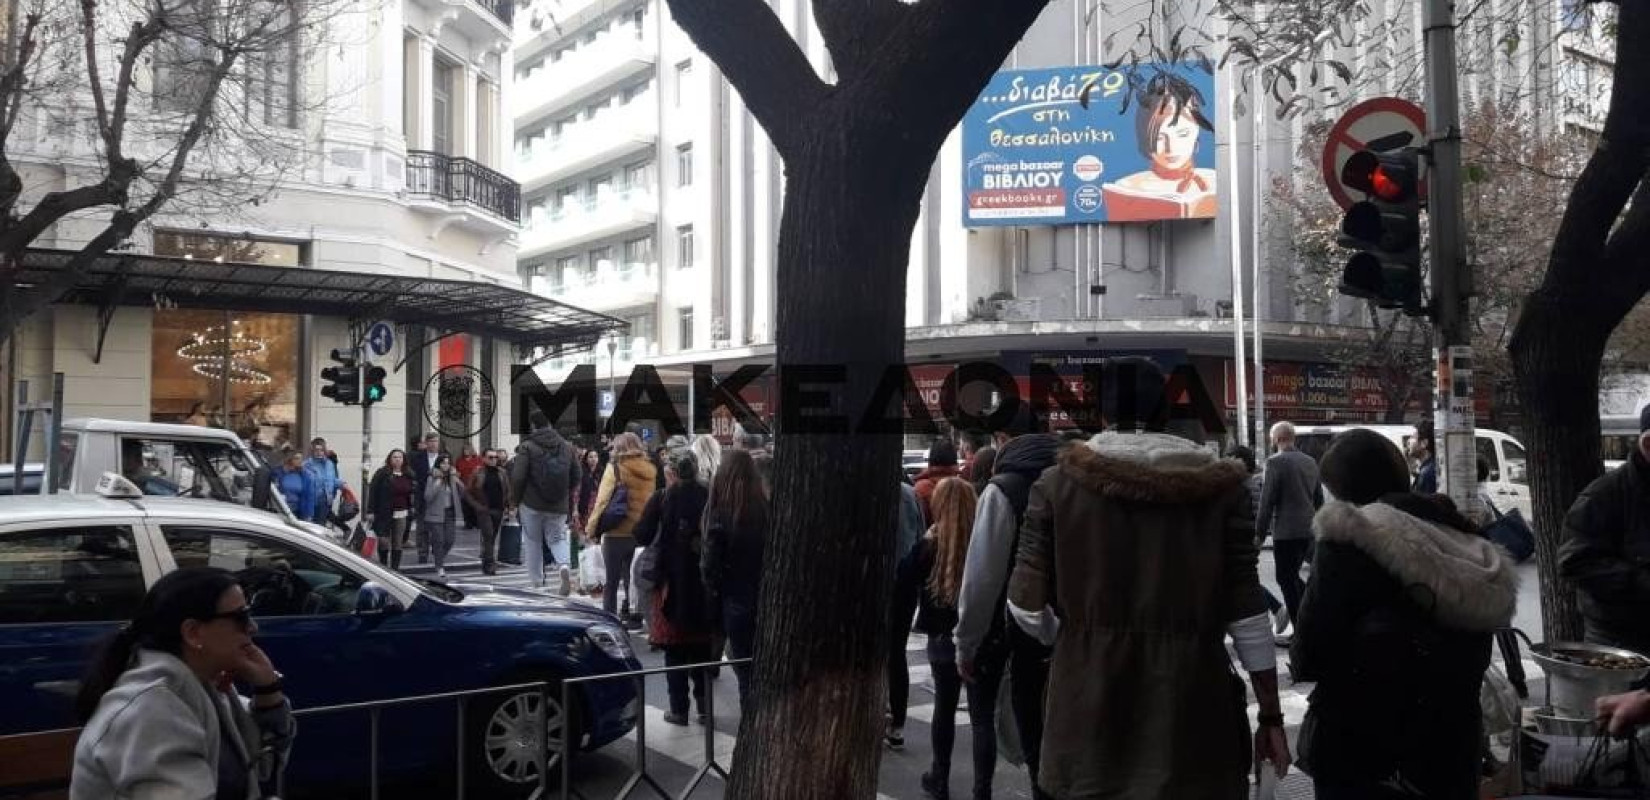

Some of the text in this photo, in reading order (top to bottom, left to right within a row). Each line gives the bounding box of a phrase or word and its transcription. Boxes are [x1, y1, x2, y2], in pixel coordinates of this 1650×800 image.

[1033, 109, 1070, 121] στη
[983, 161, 1019, 173] mega
[1020, 159, 1064, 171] bazaar
[983, 171, 1064, 189] ΒΙΒΛΙΟΥ
